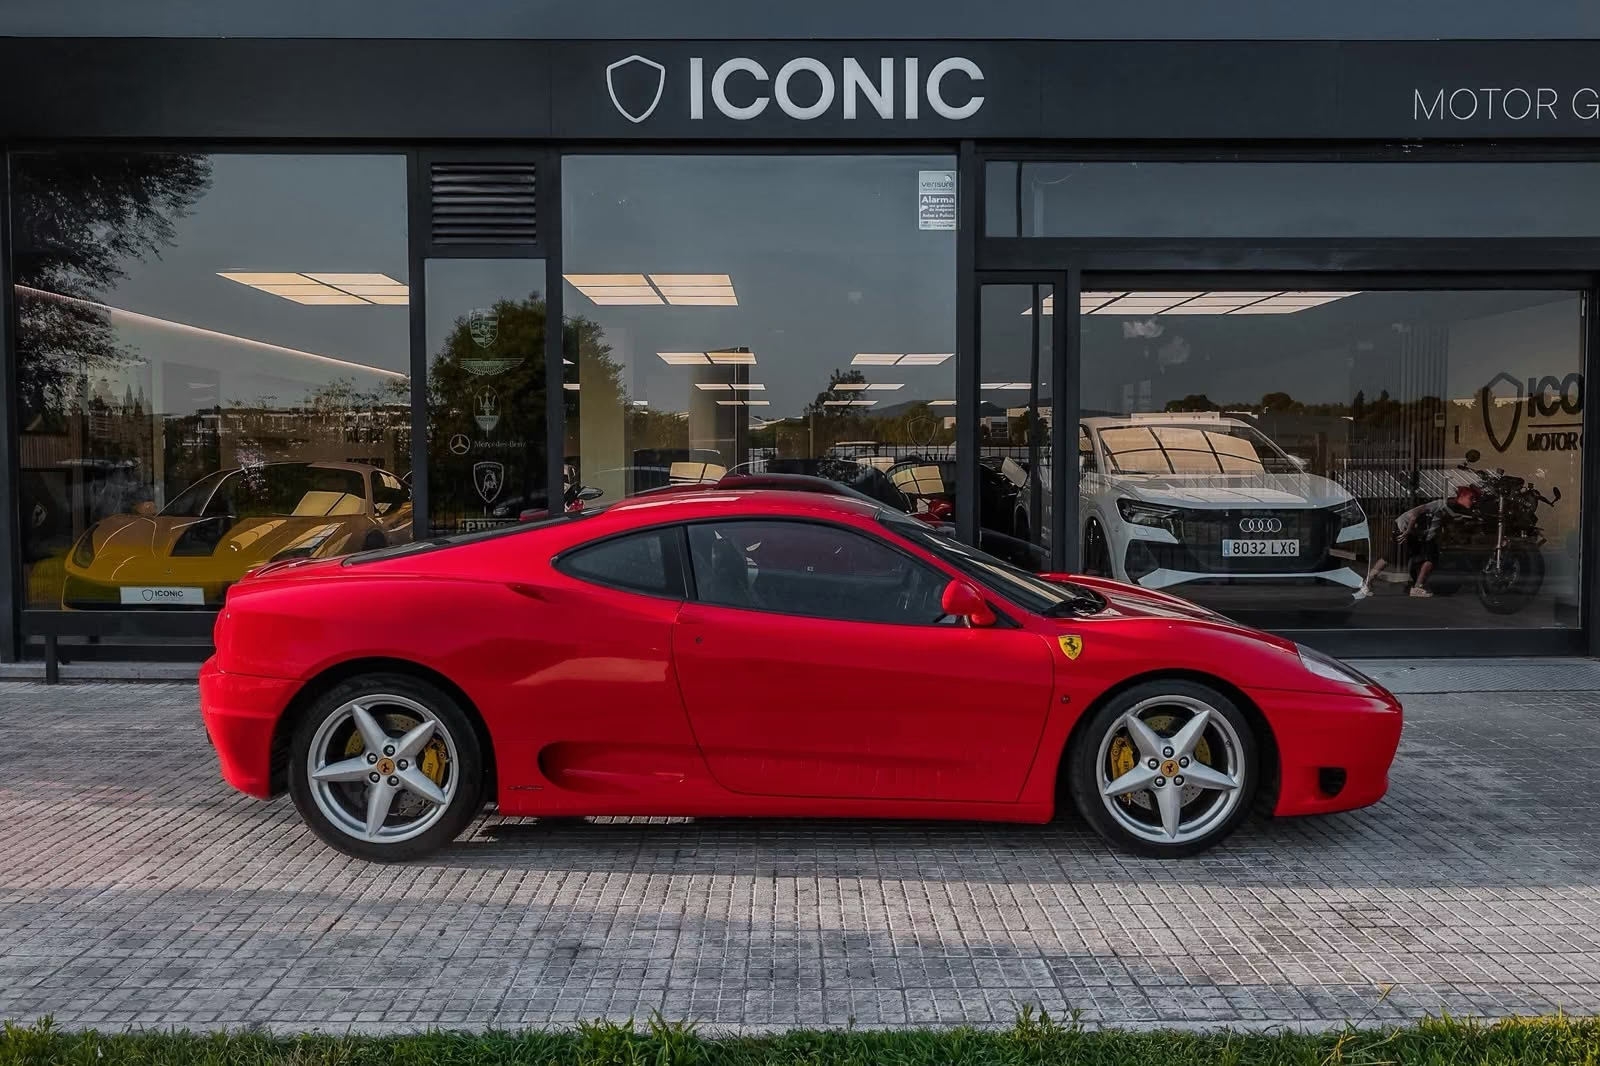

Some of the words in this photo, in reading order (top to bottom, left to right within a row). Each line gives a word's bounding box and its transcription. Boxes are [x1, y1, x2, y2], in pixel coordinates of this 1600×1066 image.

[690, 57, 985, 120] ICONIC
[1414, 88, 1558, 120] MOTOR
[921, 195, 954, 204] Alarma
[1527, 432, 1579, 451] MOTOR
[1233, 541, 1266, 555] 8032
[1271, 541, 1296, 555] LXG
